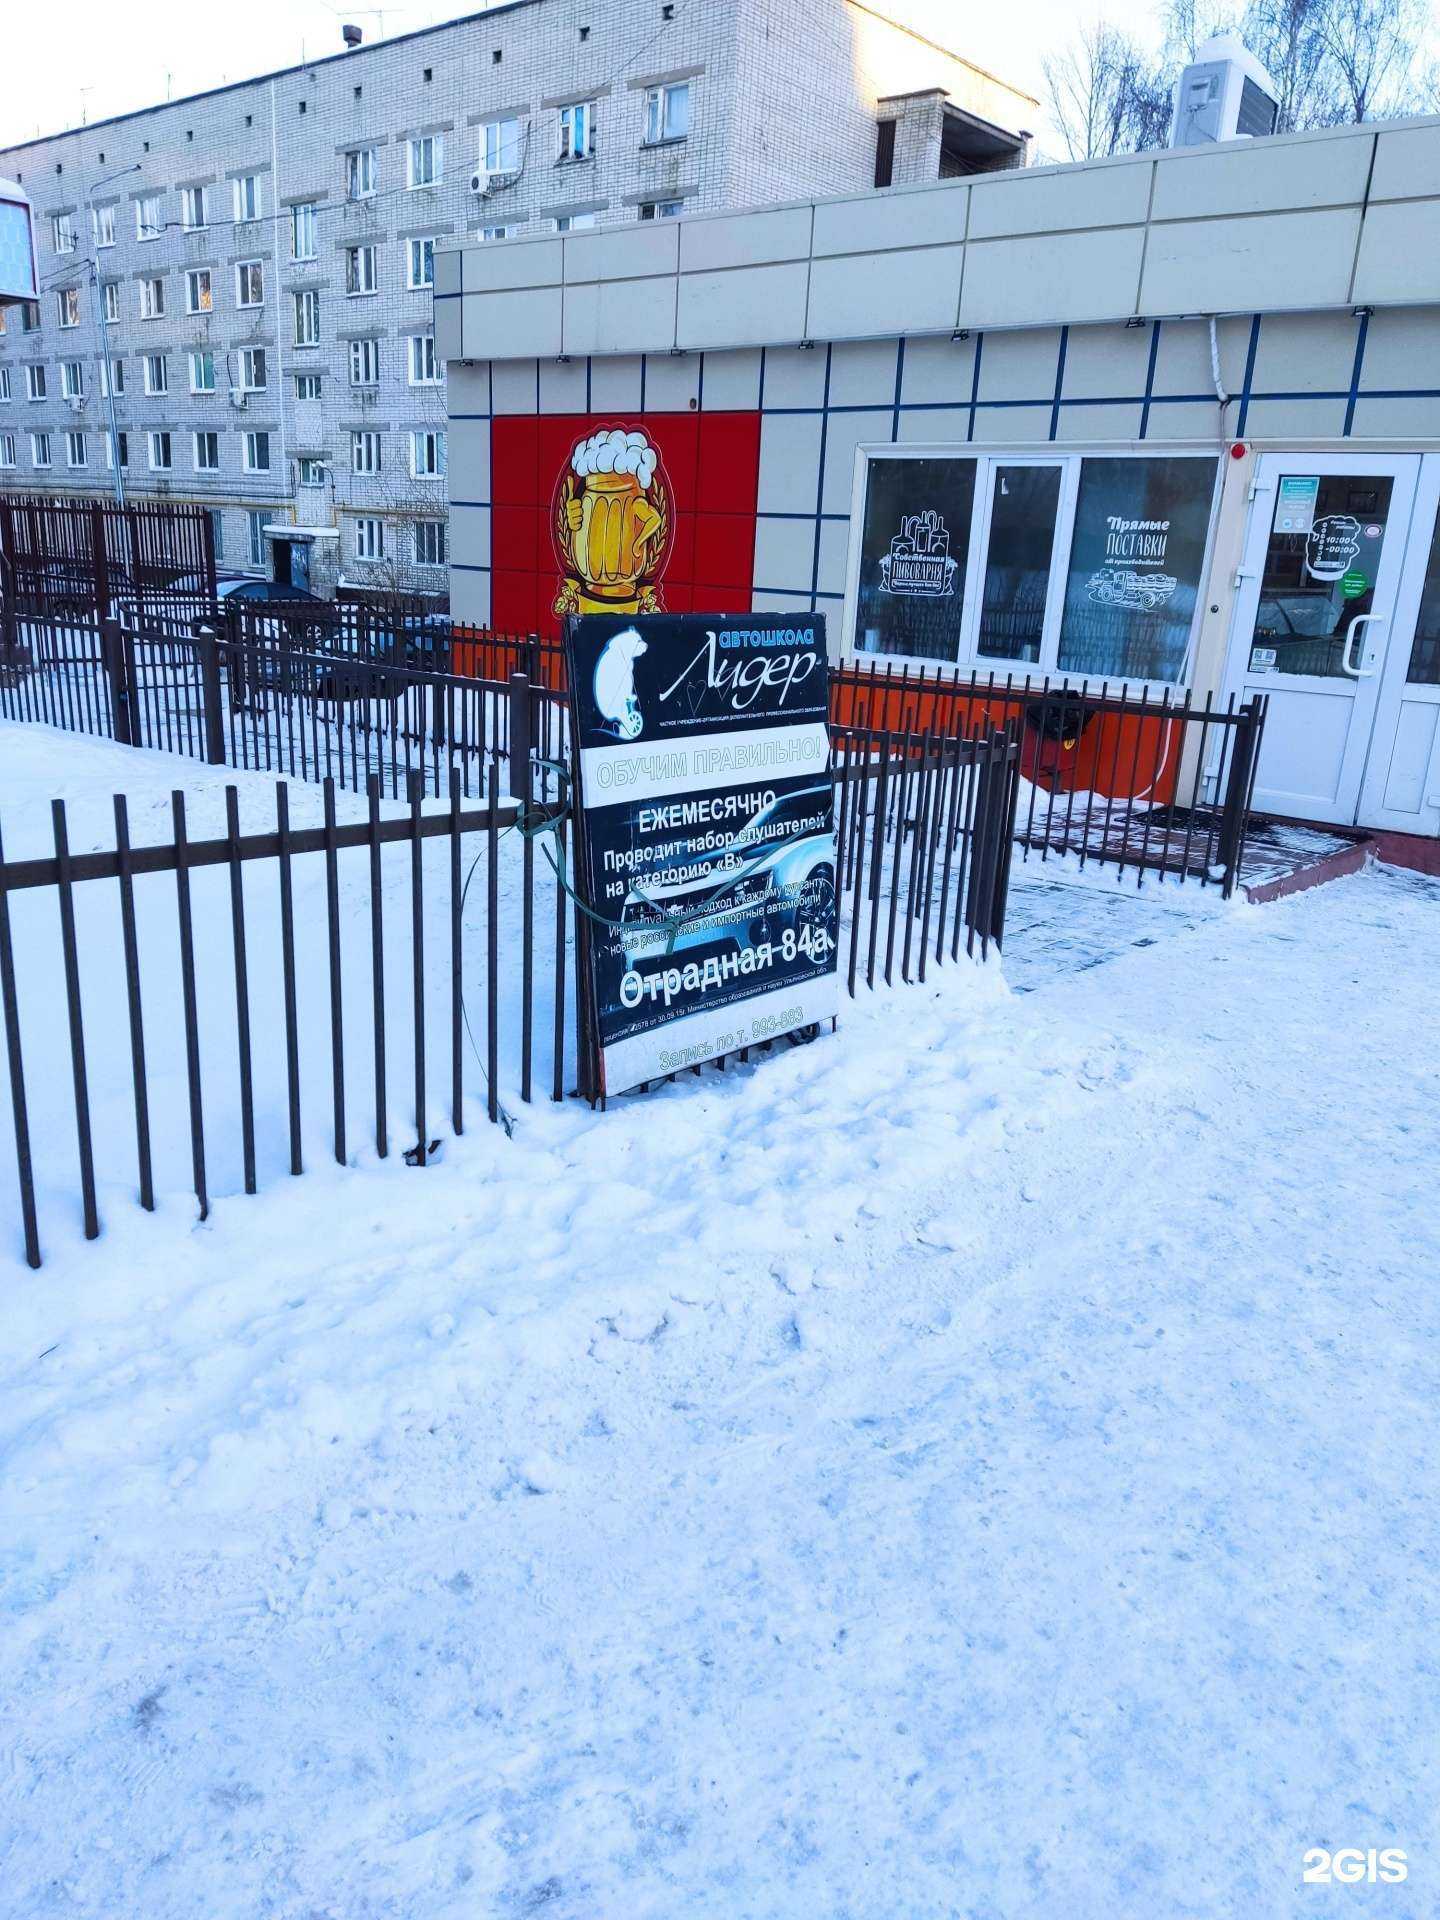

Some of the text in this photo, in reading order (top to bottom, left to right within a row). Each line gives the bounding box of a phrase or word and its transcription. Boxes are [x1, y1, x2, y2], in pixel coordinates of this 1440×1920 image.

[1106, 516, 1170, 533] Прямые
[1325, 536, 1351, 544] 10:00
[892, 552, 945, 562] Собственная
[1106, 533, 1168, 556] ПОСТАВКИ
[892, 560, 943, 581] ПИВОВАРНЯ
[659, 631, 817, 709] Лидер
[597, 736, 821, 789] ОБУЧИМ ПРАВИЛЬНО!
[639, 790, 776, 833] ЕЖЕМЕСЯЧНО
[603, 811, 826, 873] Проводит набор слушателей
[606, 880, 625, 898] на
[628, 860, 712, 892] категорию
[742, 887, 783, 905] каждому
[784, 877, 824, 898] курсанту
[610, 935, 640, 958] новые
[640, 921, 701, 950] россиские
[710, 907, 765, 927] импортные
[766, 894, 821, 914] автомобили
[659, 1041, 713, 1071] Запись
[716, 1033, 734, 1051] по
